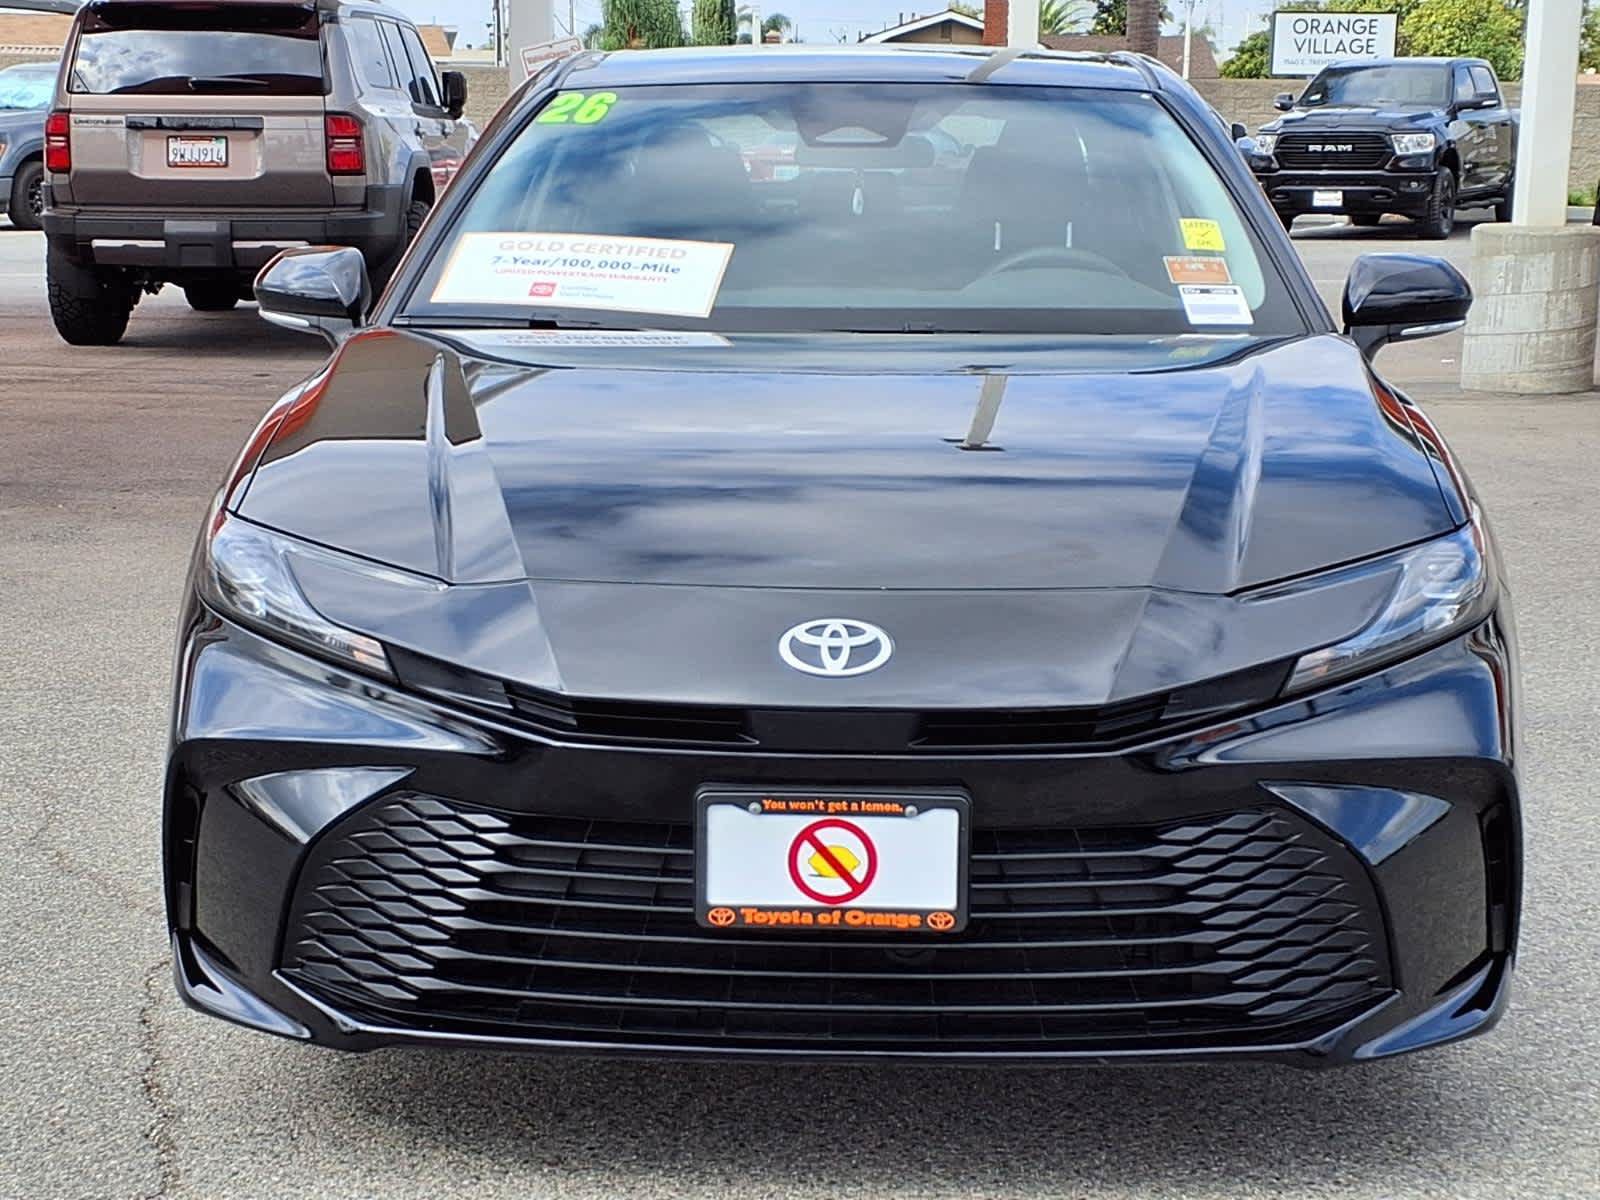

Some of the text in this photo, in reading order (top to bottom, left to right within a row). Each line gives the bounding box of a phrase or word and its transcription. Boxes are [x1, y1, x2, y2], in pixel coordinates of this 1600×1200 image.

[1293, 18, 1378, 35] ORANGE
[1294, 38, 1376, 54] VILLAGE
[536, 92, 618, 125] 26
[1308, 144, 1353, 152] RAM
[498, 240, 687, 259] GOLD CERTIFIED
[490, 256, 681, 274] 7-Year/100,000-Mile
[762, 799, 904, 814] You won't get a lemon.
[740, 908, 922, 928] Toyota of Orange
